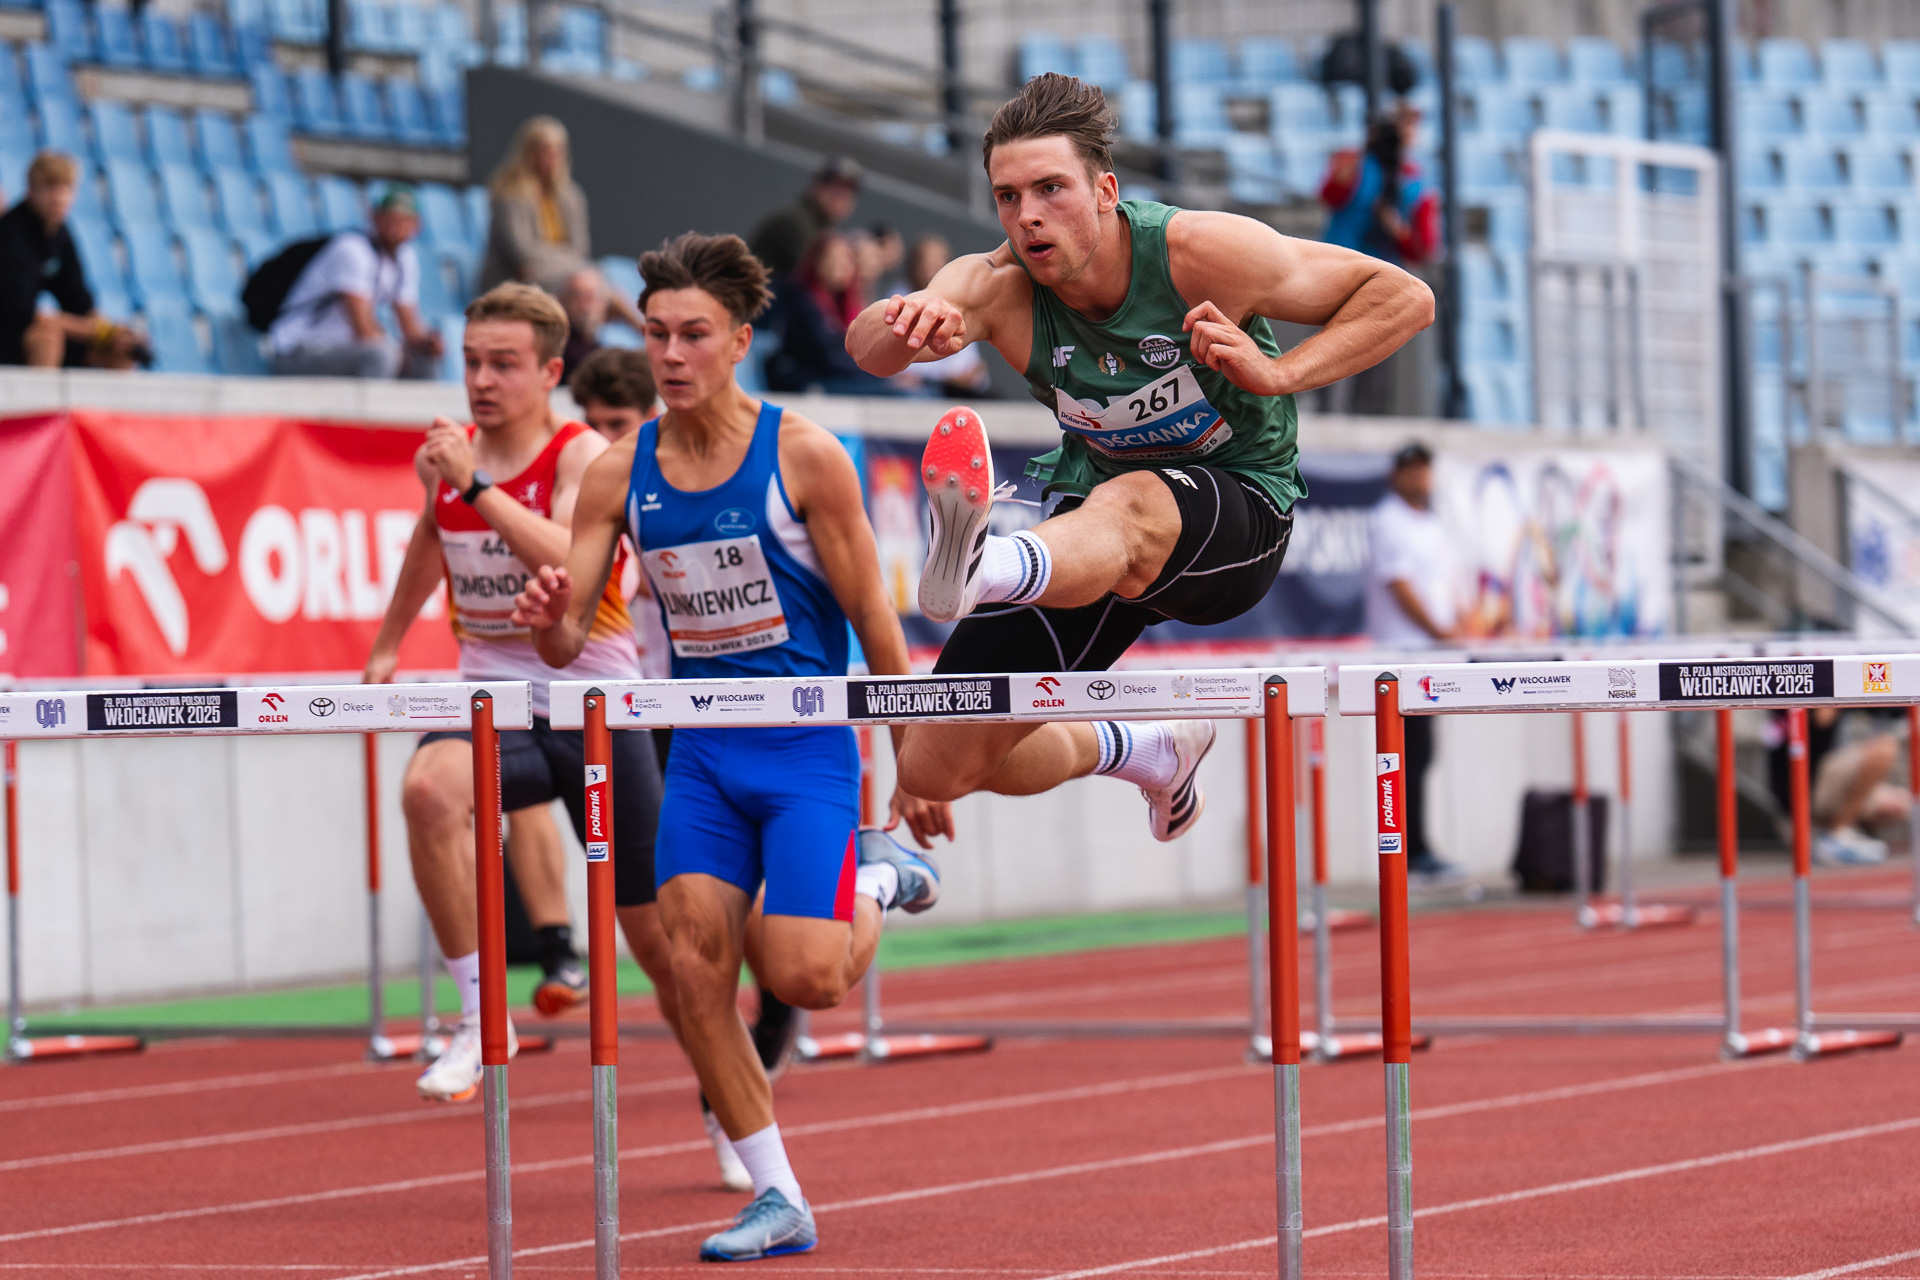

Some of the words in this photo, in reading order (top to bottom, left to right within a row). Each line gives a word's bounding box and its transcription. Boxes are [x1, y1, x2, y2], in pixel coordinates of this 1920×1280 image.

[1145, 340, 1168, 348] AZS
[1150, 350, 1174, 363] AWF
[1129, 377, 1180, 422] 267
[1060, 411, 1092, 428] polanik
[1188, 436, 1218, 456] 2025
[481, 538, 515, 557] 44
[714, 545, 743, 569] 18
[1679, 667, 1691, 677] 79.
[1692, 666, 1711, 677] PZLA
[1713, 665, 1767, 676] MISTRZOSTWA
[1769, 664, 1796, 675] POLSKI
[1798, 664, 1814, 674] U20
[1194, 677, 1237, 685] Ministerstwo
[1519, 675, 1571, 684] WŁOCŁAWEK
[1679, 676, 1773, 696] WŁOCŁAWEK
[1775, 675, 1814, 694] 2025
[865, 685, 877, 696] 79.
[878, 684, 896, 695] PZLA
[897, 682, 948, 694] MISTRZOSTWA
[949, 681, 975, 692] POLSKI
[976, 681, 991, 691] U20
[1123, 684, 1157, 695] Okęcie
[1194, 685, 1216, 694] Sportu
[1221, 684, 1252, 694] Turystyki
[1864, 683, 1890, 691] PZLA
[103, 698, 114, 708] 79.
[115, 697, 131, 708] PZLA
[133, 697, 180, 707] MISTRZOSTWA
[181, 696, 205, 706] POLSKI
[206, 695, 221, 705] U20
[716, 694, 765, 702] WŁOCŁAWEK
[866, 693, 953, 714] WŁOCŁAWEK
[956, 691, 992, 711] 2025
[1032, 698, 1065, 708] ORLEN
[342, 702, 374, 714] Okęcie
[408, 704, 430, 712] Sportu
[104, 706, 185, 726] WŁOCŁAWEK
[187, 706, 221, 724] 2025
[258, 714, 289, 723] ORLEN
[1381, 779, 1396, 828] polanik
[588, 790, 604, 837] polanik
